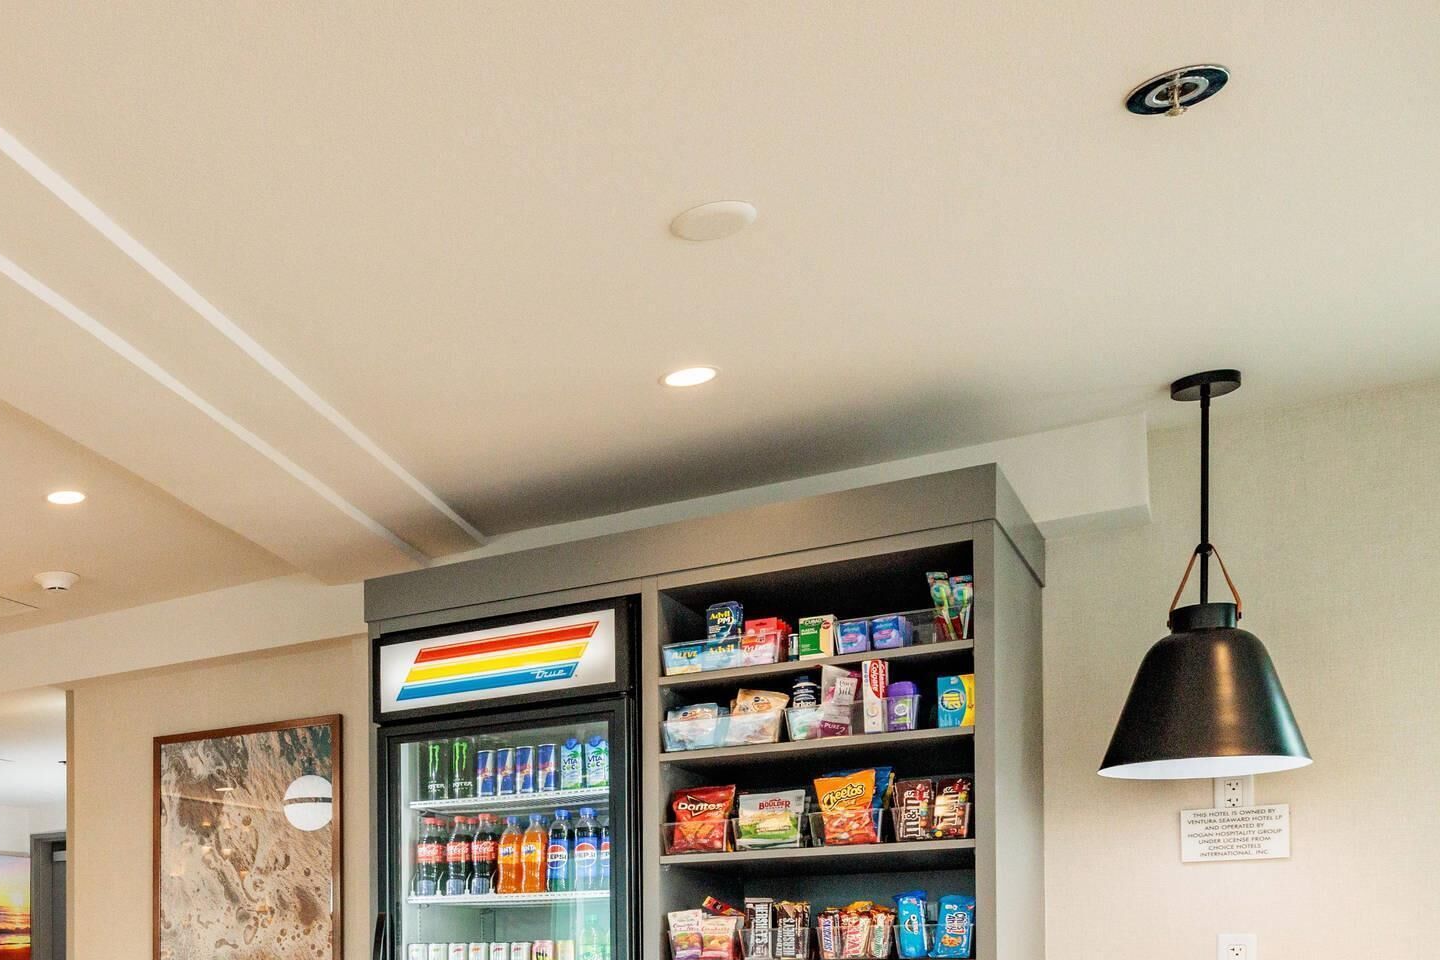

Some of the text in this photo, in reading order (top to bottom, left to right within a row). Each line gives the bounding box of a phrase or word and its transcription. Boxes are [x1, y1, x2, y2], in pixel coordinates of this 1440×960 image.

[709, 611, 730, 620] Advil
[717, 616, 731, 625] PM
[530, 669, 567, 679] True
[871, 662, 879, 692] Colgate
[822, 782, 865, 809] Cheetos
[678, 801, 723, 812] Doritos
[758, 799, 791, 810] BOULDER
[782, 917, 796, 956] HERSHEY'S
